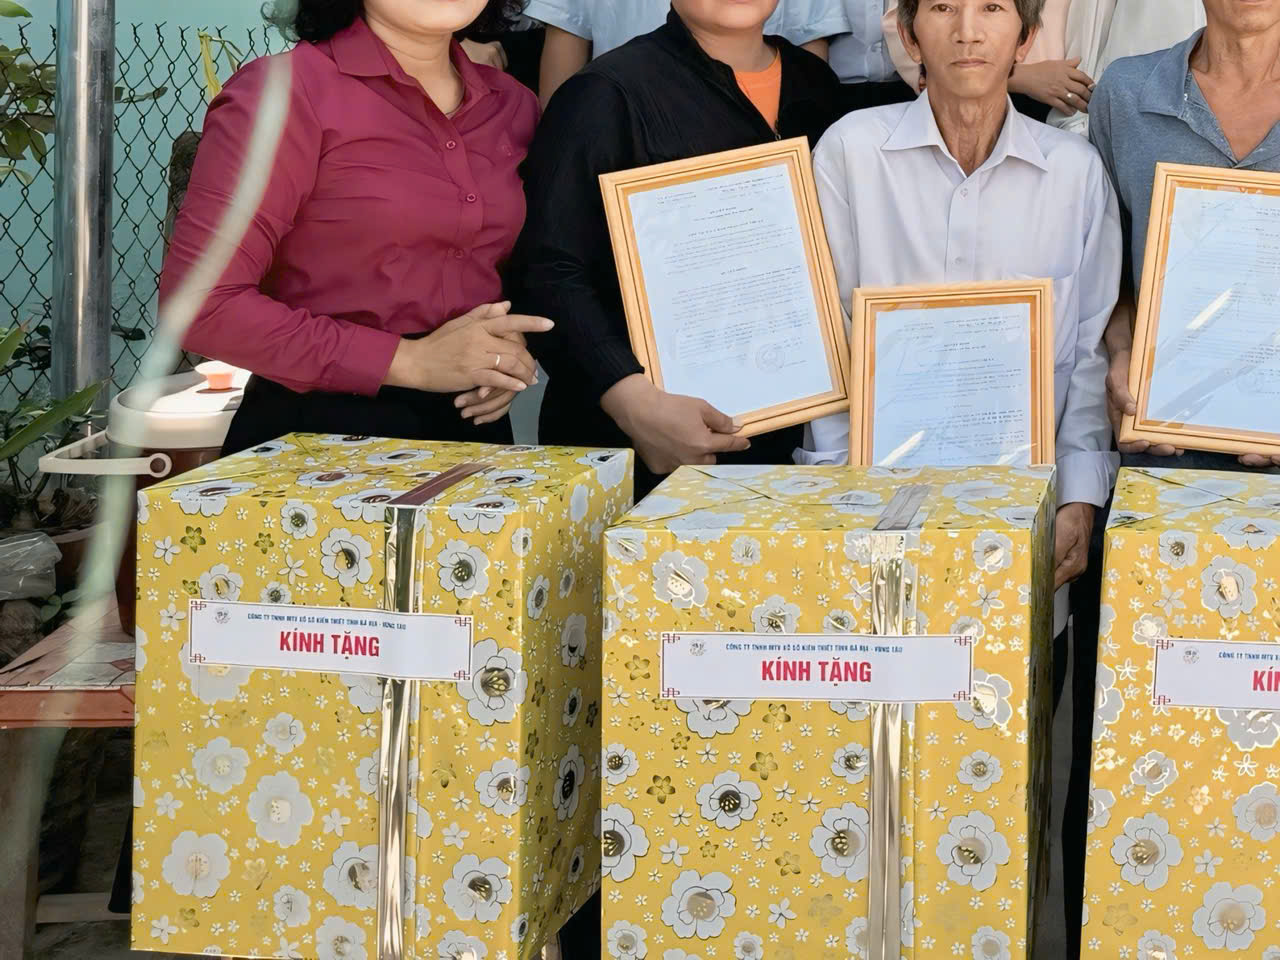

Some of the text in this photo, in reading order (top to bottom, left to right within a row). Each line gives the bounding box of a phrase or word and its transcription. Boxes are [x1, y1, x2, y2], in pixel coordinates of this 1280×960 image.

[280, 628, 380, 660] KÍNH TẶNG
[761, 656, 872, 686] KÍNH TẶNG
